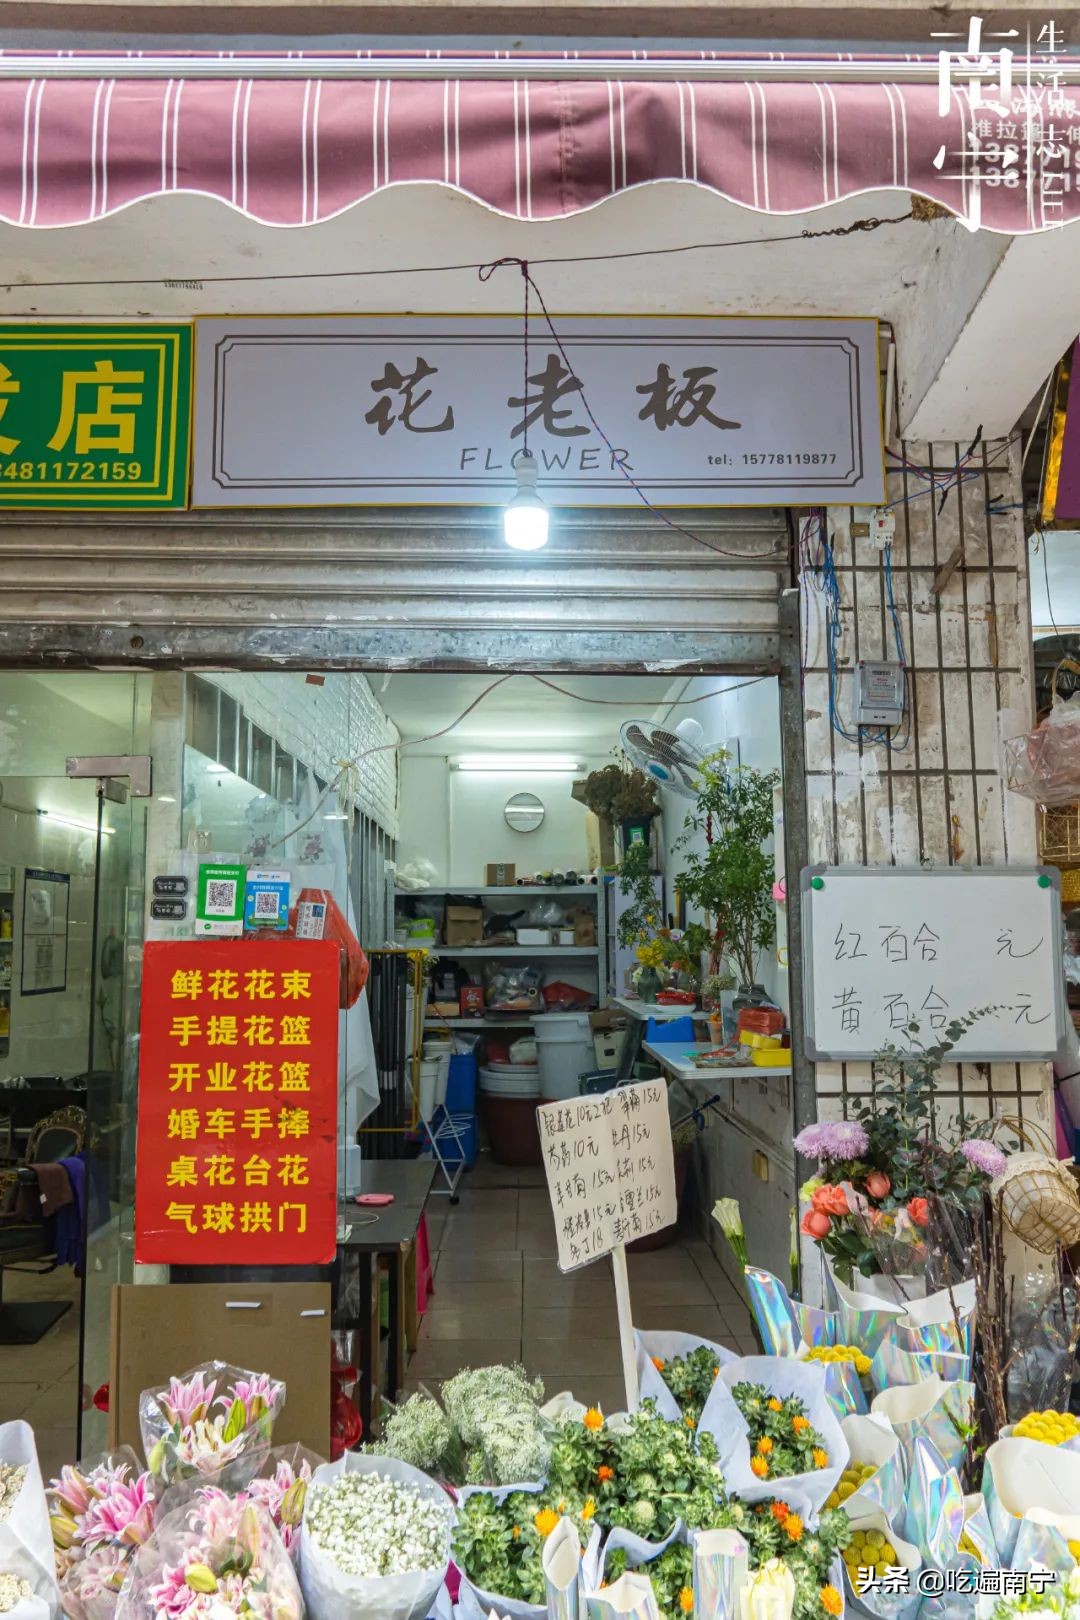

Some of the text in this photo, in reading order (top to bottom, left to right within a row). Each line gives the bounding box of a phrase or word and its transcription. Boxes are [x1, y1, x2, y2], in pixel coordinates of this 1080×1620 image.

[0, 360, 145, 455] 店
[365, 354, 741, 438] 花老板
[742, 453, 838, 466] 15778119877
[834, 923, 940, 962] 红百合
[171, 970, 312, 1000] 鲜花花束
[832, 985, 949, 1034] 黄百合
[169, 1015, 312, 1046] 手提花篮
[168, 1061, 311, 1092] 开业花篮
[167, 1108, 310, 1139] 婚车手捧
[166, 1155, 310, 1186] 桌花台花
[165, 1202, 308, 1234] 气球拱门
